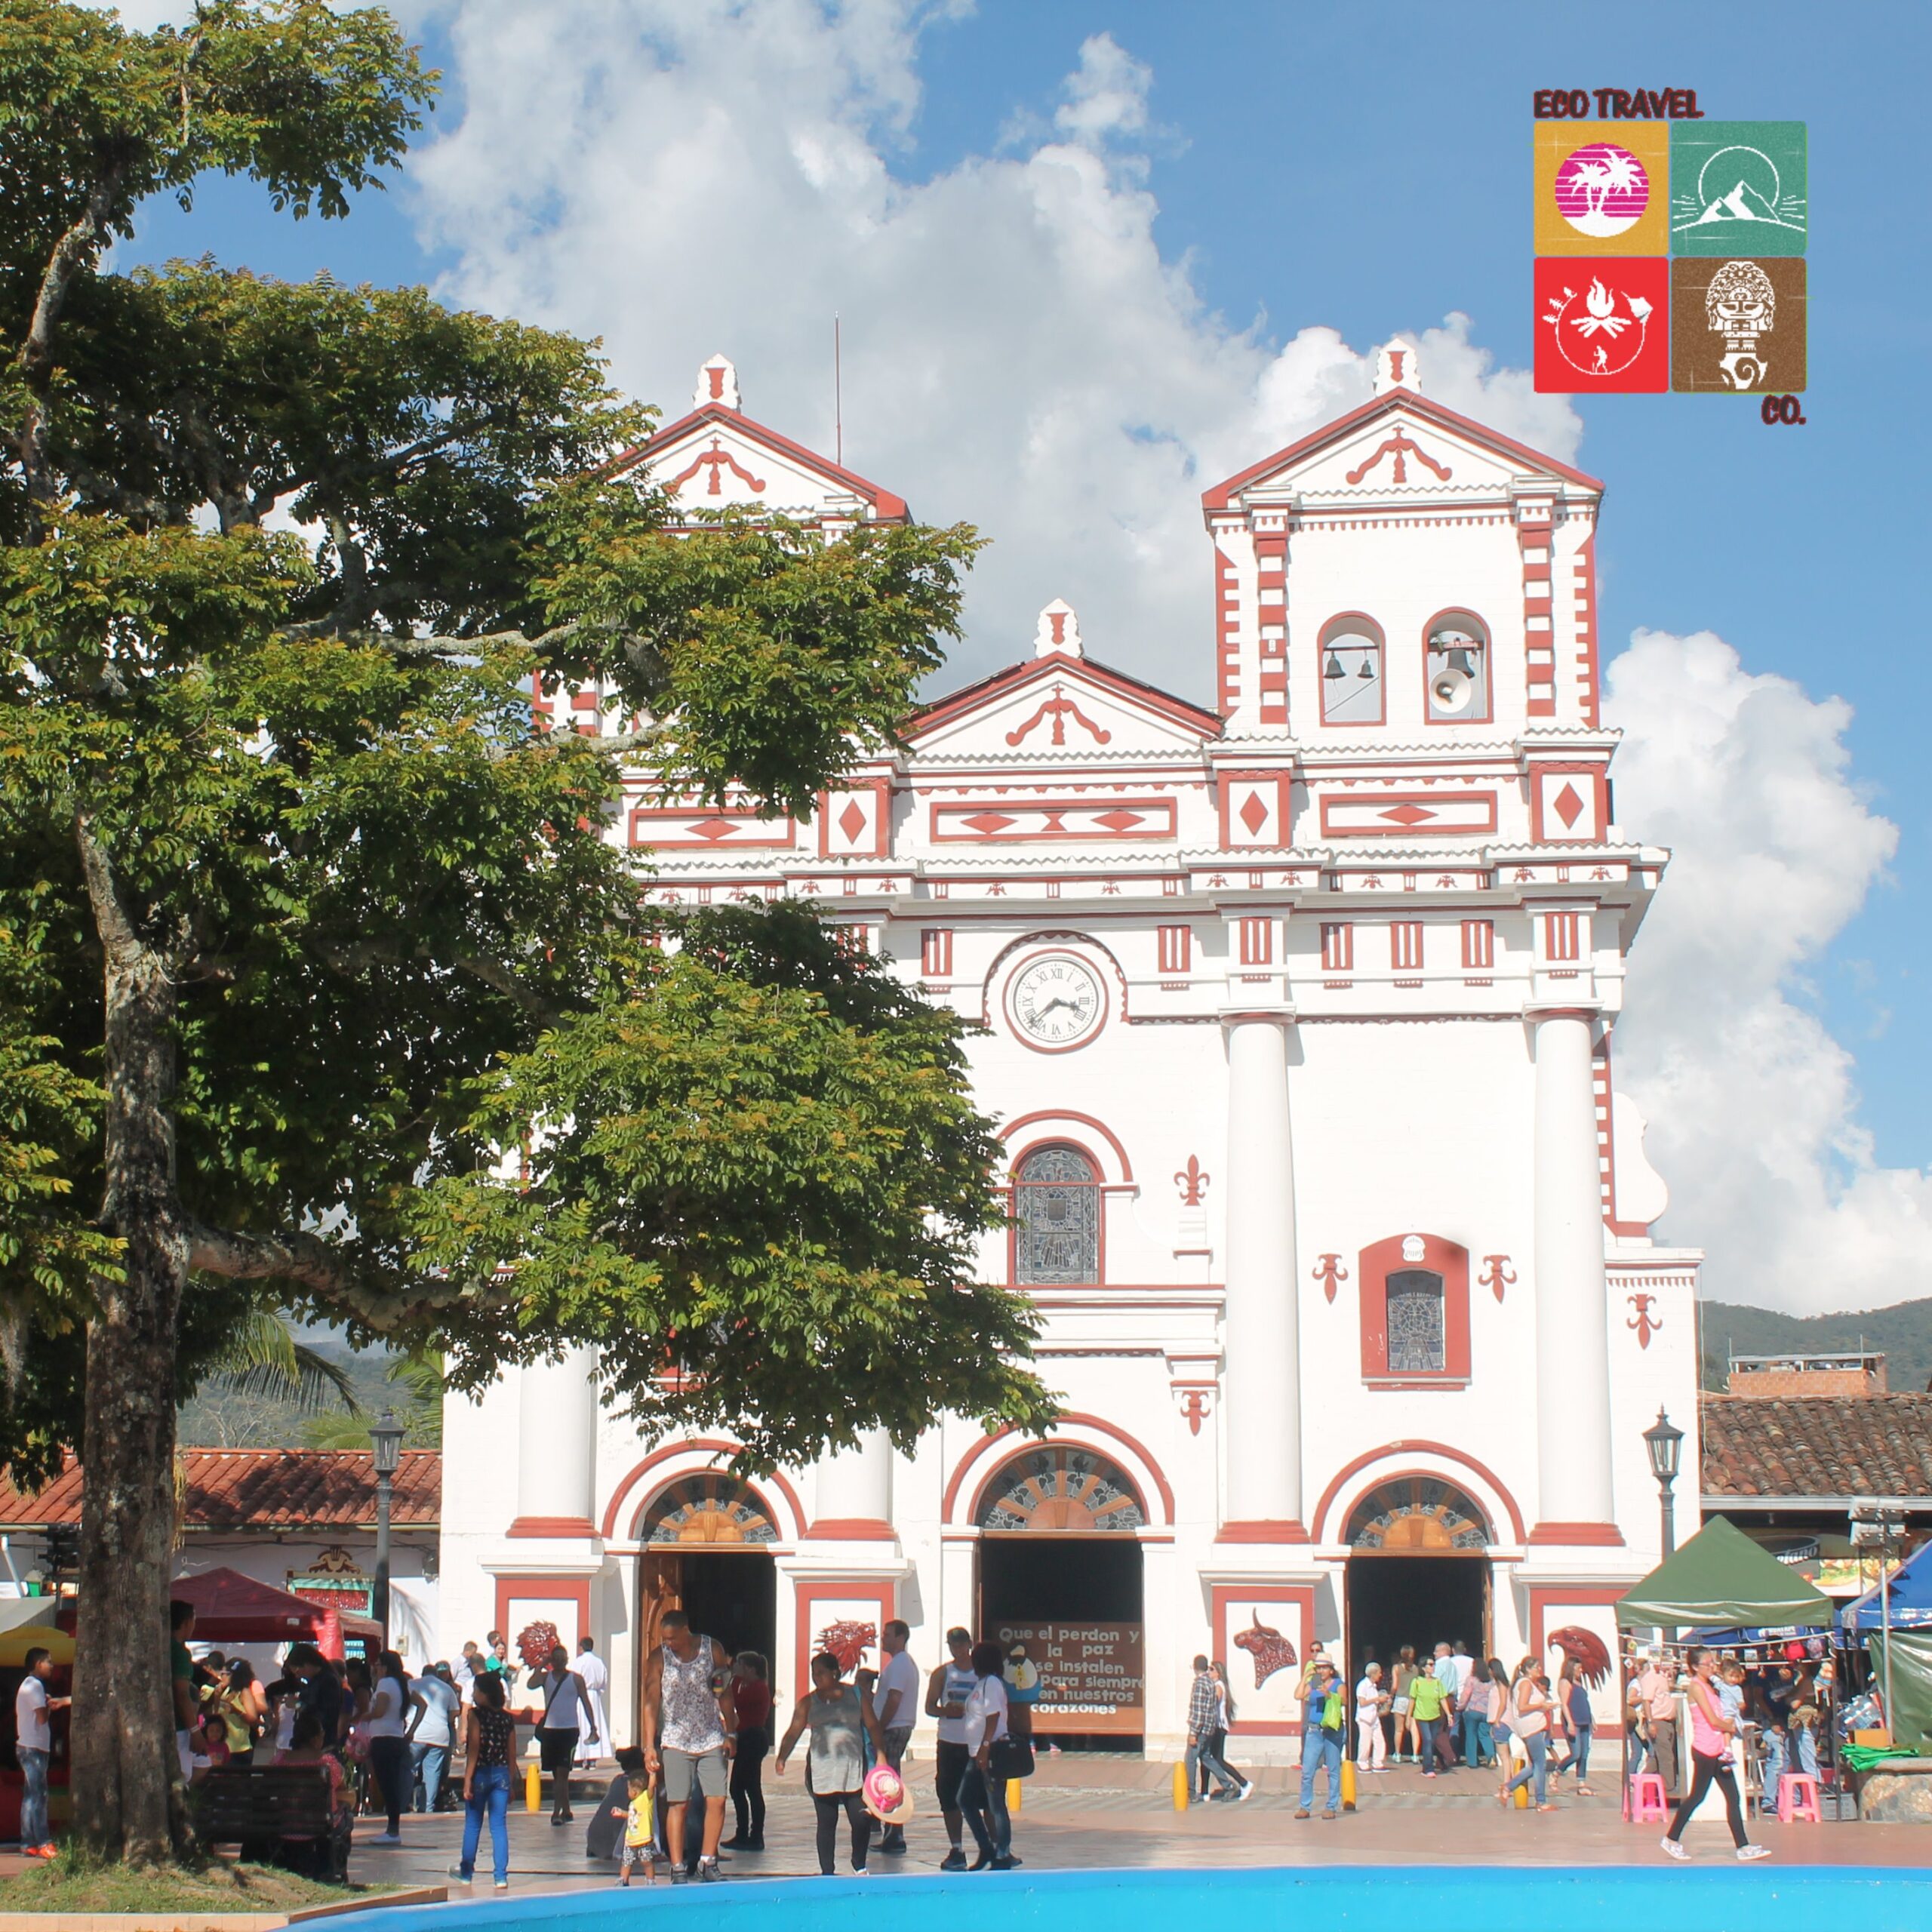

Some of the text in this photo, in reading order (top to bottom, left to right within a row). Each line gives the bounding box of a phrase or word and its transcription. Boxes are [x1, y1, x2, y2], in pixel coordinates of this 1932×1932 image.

[1036, 971, 1048, 984] XI
[1051, 968, 1063, 980] XII
[1026, 982, 1037, 994] X
[1075, 983, 1086, 992] II
[1023, 996, 1033, 1006] IX
[1051, 1023, 1061, 1035] VI
[1068, 1021, 1075, 1032] V
[999, 1626, 1140, 1643] Que el perdon y
[1048, 1644, 1114, 1657] la paz
[1035, 1659, 1124, 1675] se instalen
[1040, 1674, 1079, 1687] para
[1038, 1689, 1134, 1702] en nuestros
[1030, 1703, 1117, 1715] corazones
